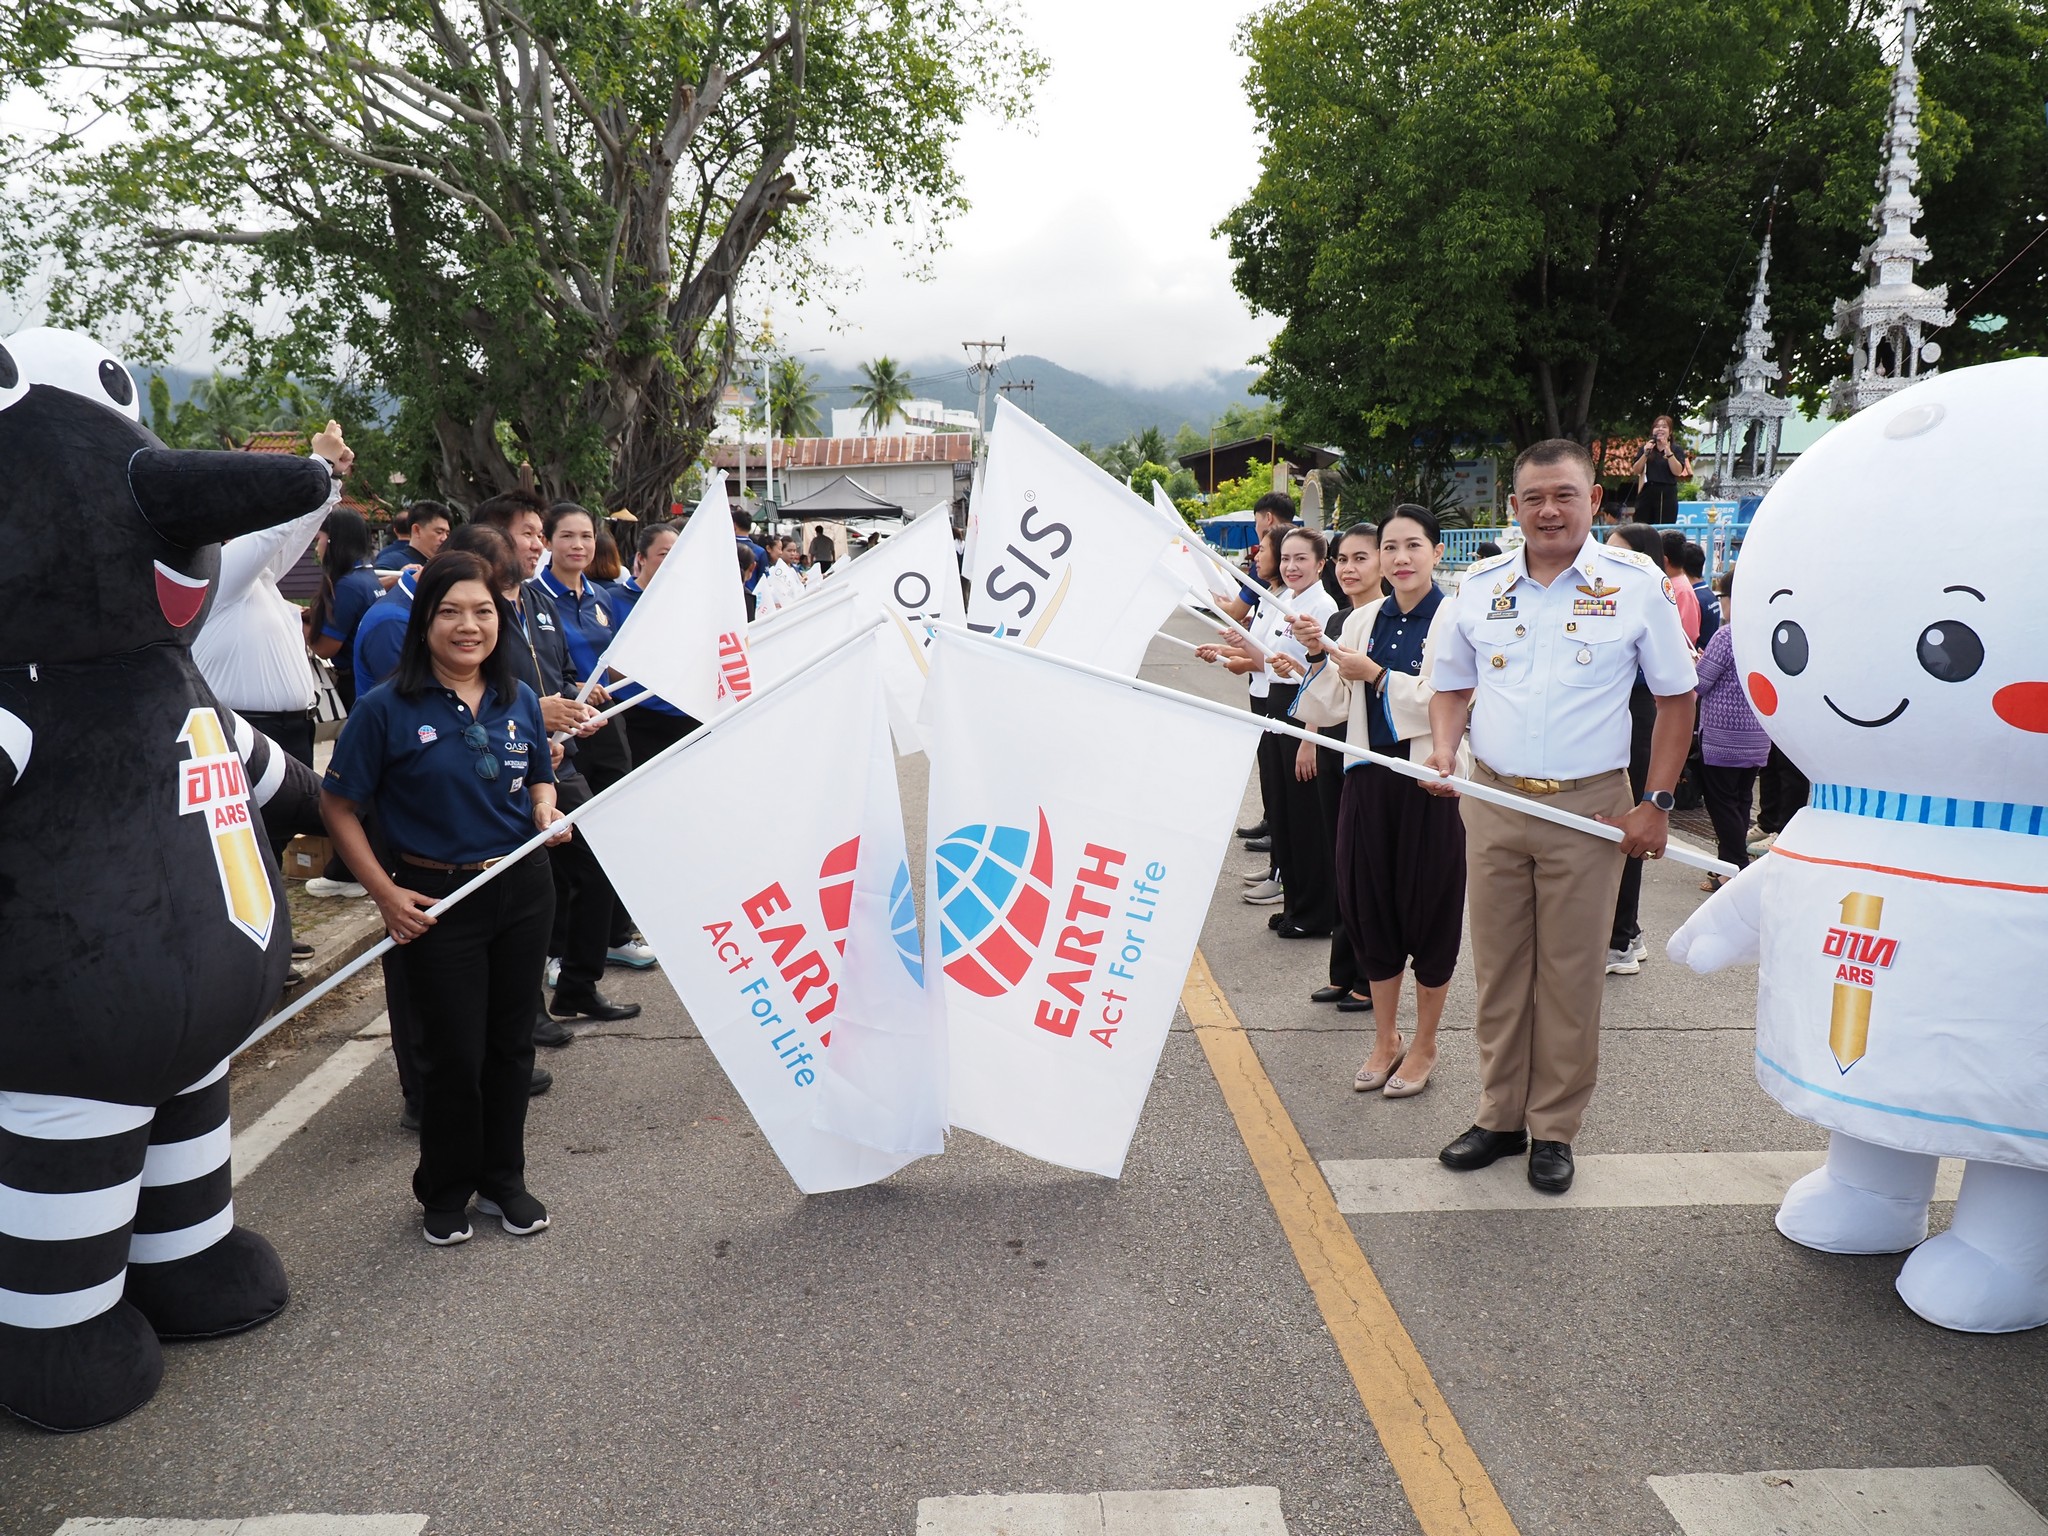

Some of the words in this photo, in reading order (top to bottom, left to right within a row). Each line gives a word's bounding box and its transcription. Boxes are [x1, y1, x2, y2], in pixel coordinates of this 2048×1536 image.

[504, 741, 529, 751] OASIS
[186, 760, 247, 806] อาท
[215, 803, 248, 829] ARS
[1125, 860, 1166, 922] Life
[741, 881, 839, 1048] EART
[1033, 842, 1127, 1038] EARTH
[1108, 929, 1146, 980] For
[1821, 926, 1899, 968] อาท
[1835, 963, 1875, 987] ARS
[702, 920, 754, 975] Act
[740, 976, 783, 1028] For
[771, 1028, 815, 1087] Life
[1089, 988, 1128, 1049] Act
